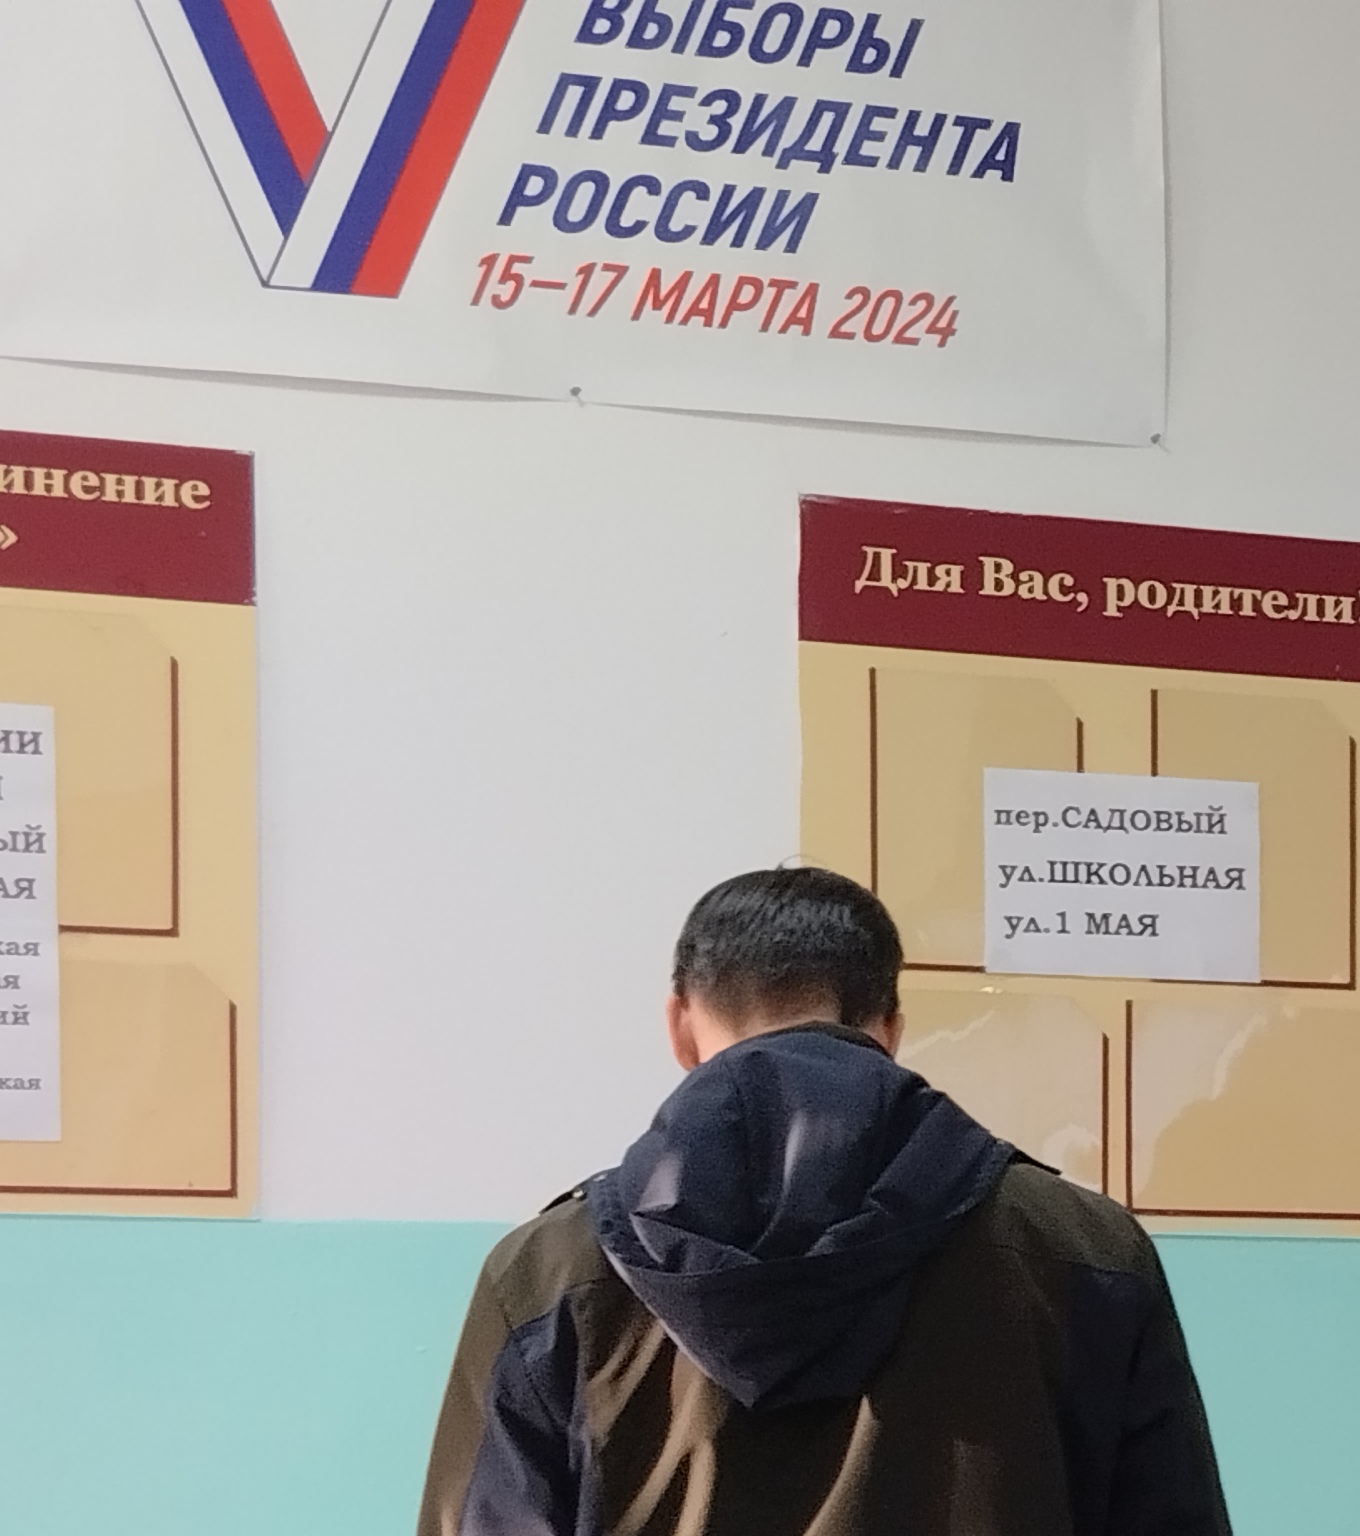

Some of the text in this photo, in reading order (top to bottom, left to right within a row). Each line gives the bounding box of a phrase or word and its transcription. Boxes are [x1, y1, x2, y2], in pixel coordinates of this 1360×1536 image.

[574, 0, 925, 78] ВЫБОРЫ
[536, 72, 1021, 183] ПРЕЗИДЕНТА
[496, 163, 819, 254] РОССИИ
[630, 267, 820, 336] МАРТА
[828, 286, 959, 348] 2024
[855, 546, 965, 597] Для
[979, 556, 1089, 612] Вас,
[994, 805, 1227, 834] пер.САДОВЫЙ
[998, 860, 1246, 890] ул.ШКОЛЬНАЯ
[1004, 911, 1159, 939] ул.1 МАЯ
